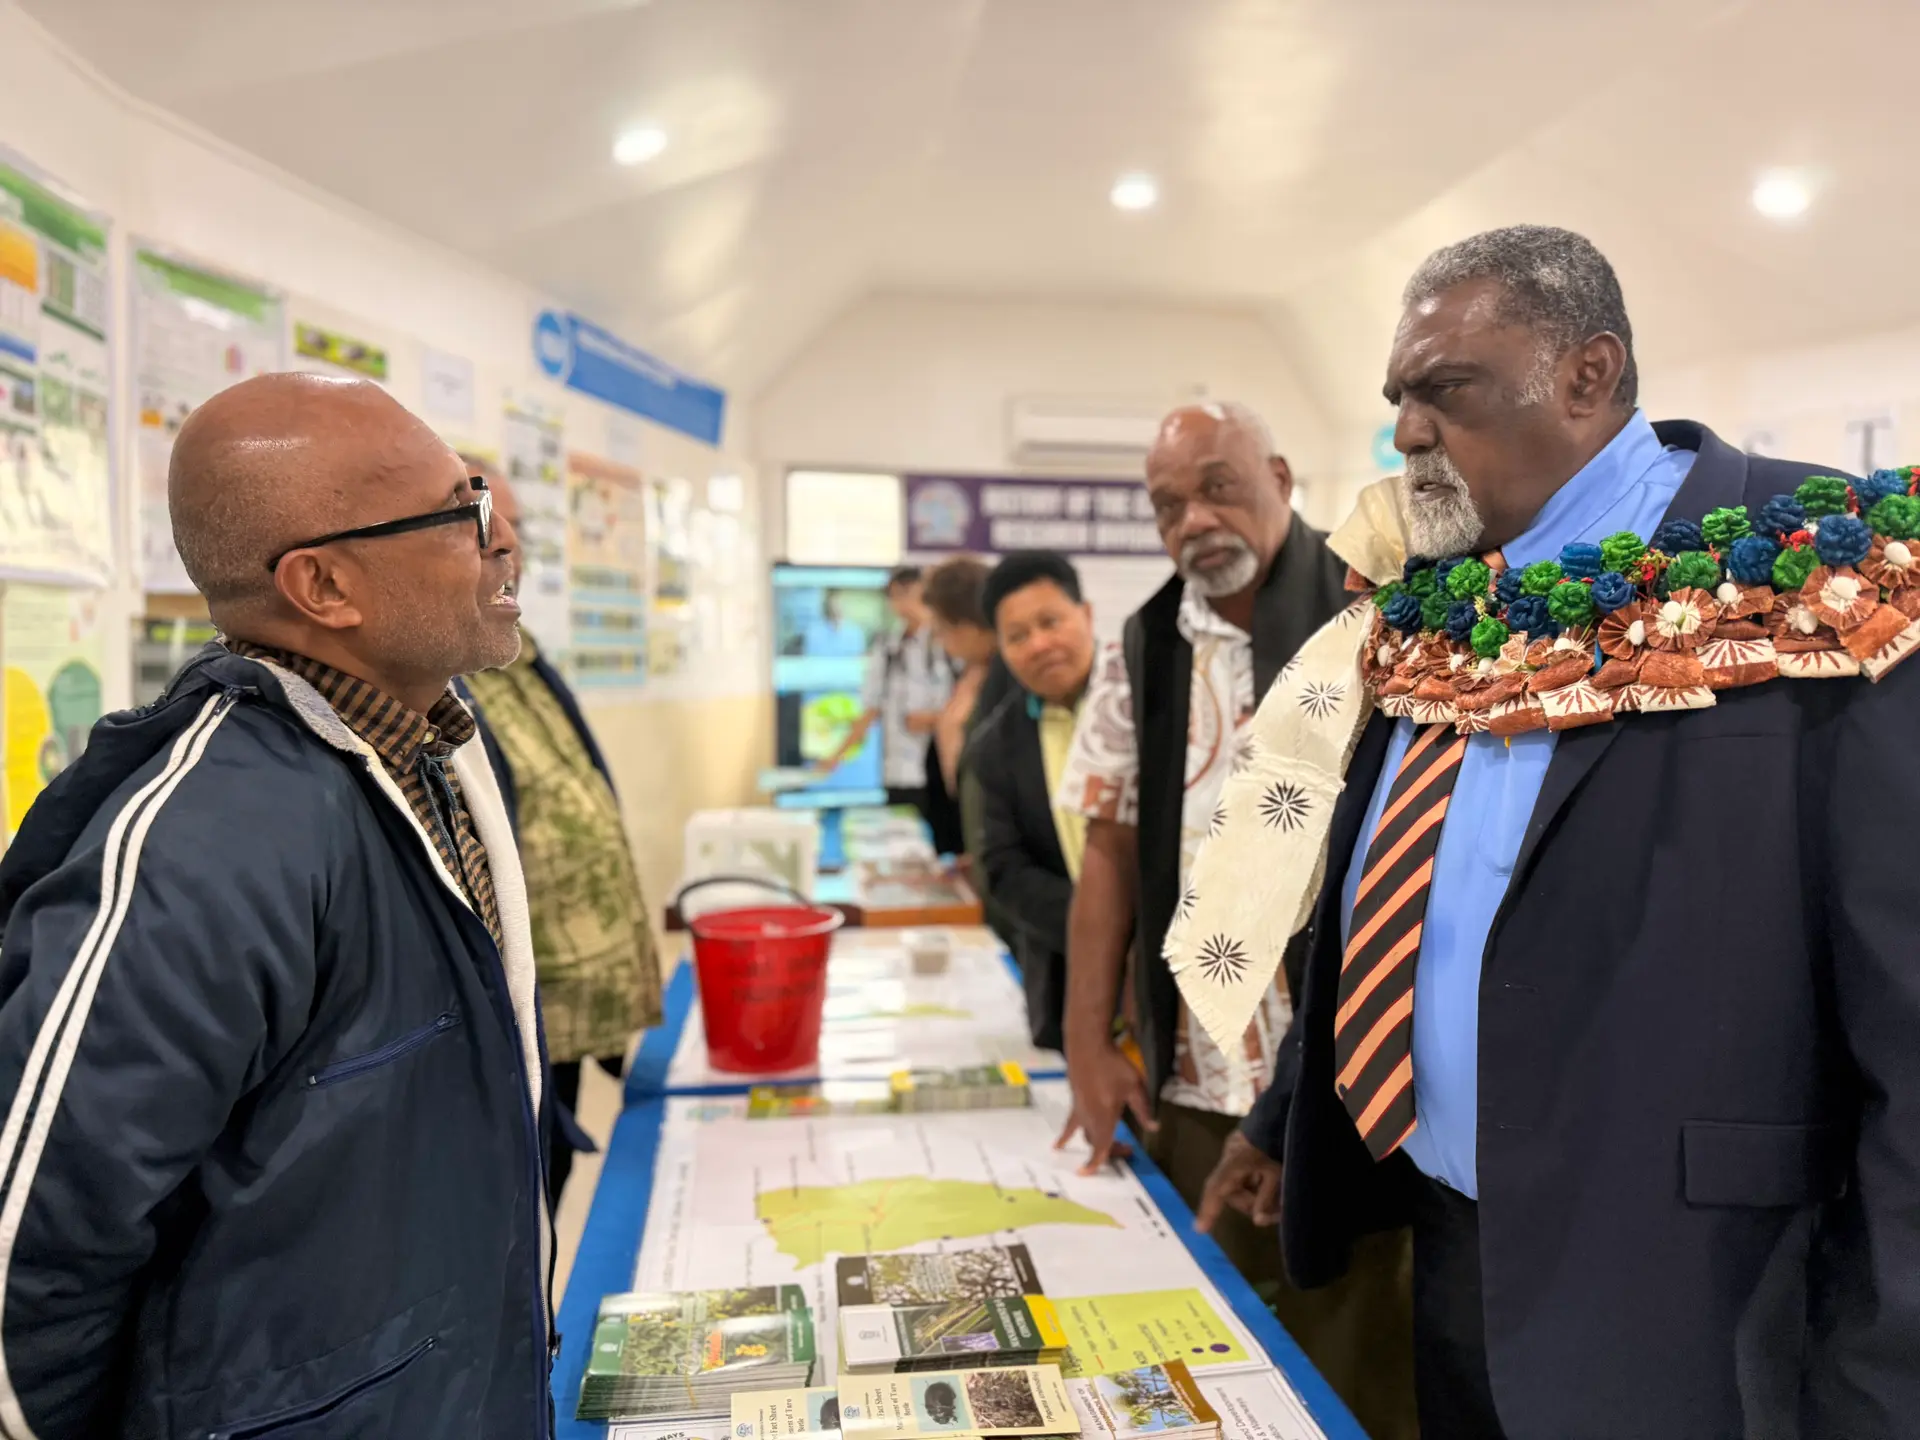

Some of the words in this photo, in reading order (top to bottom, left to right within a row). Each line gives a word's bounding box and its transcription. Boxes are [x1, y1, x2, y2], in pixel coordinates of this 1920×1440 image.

[875, 1388, 883, 1404] Sheet
[890, 1396, 898, 1404] of
[785, 1398, 793, 1412] Taro
[876, 1403, 884, 1418] Fact
[769, 1404, 777, 1421] Sheet
[785, 1413, 793, 1421] of
[770, 1421, 778, 1435] Fact
[798, 1417, 806, 1433] Beetle
